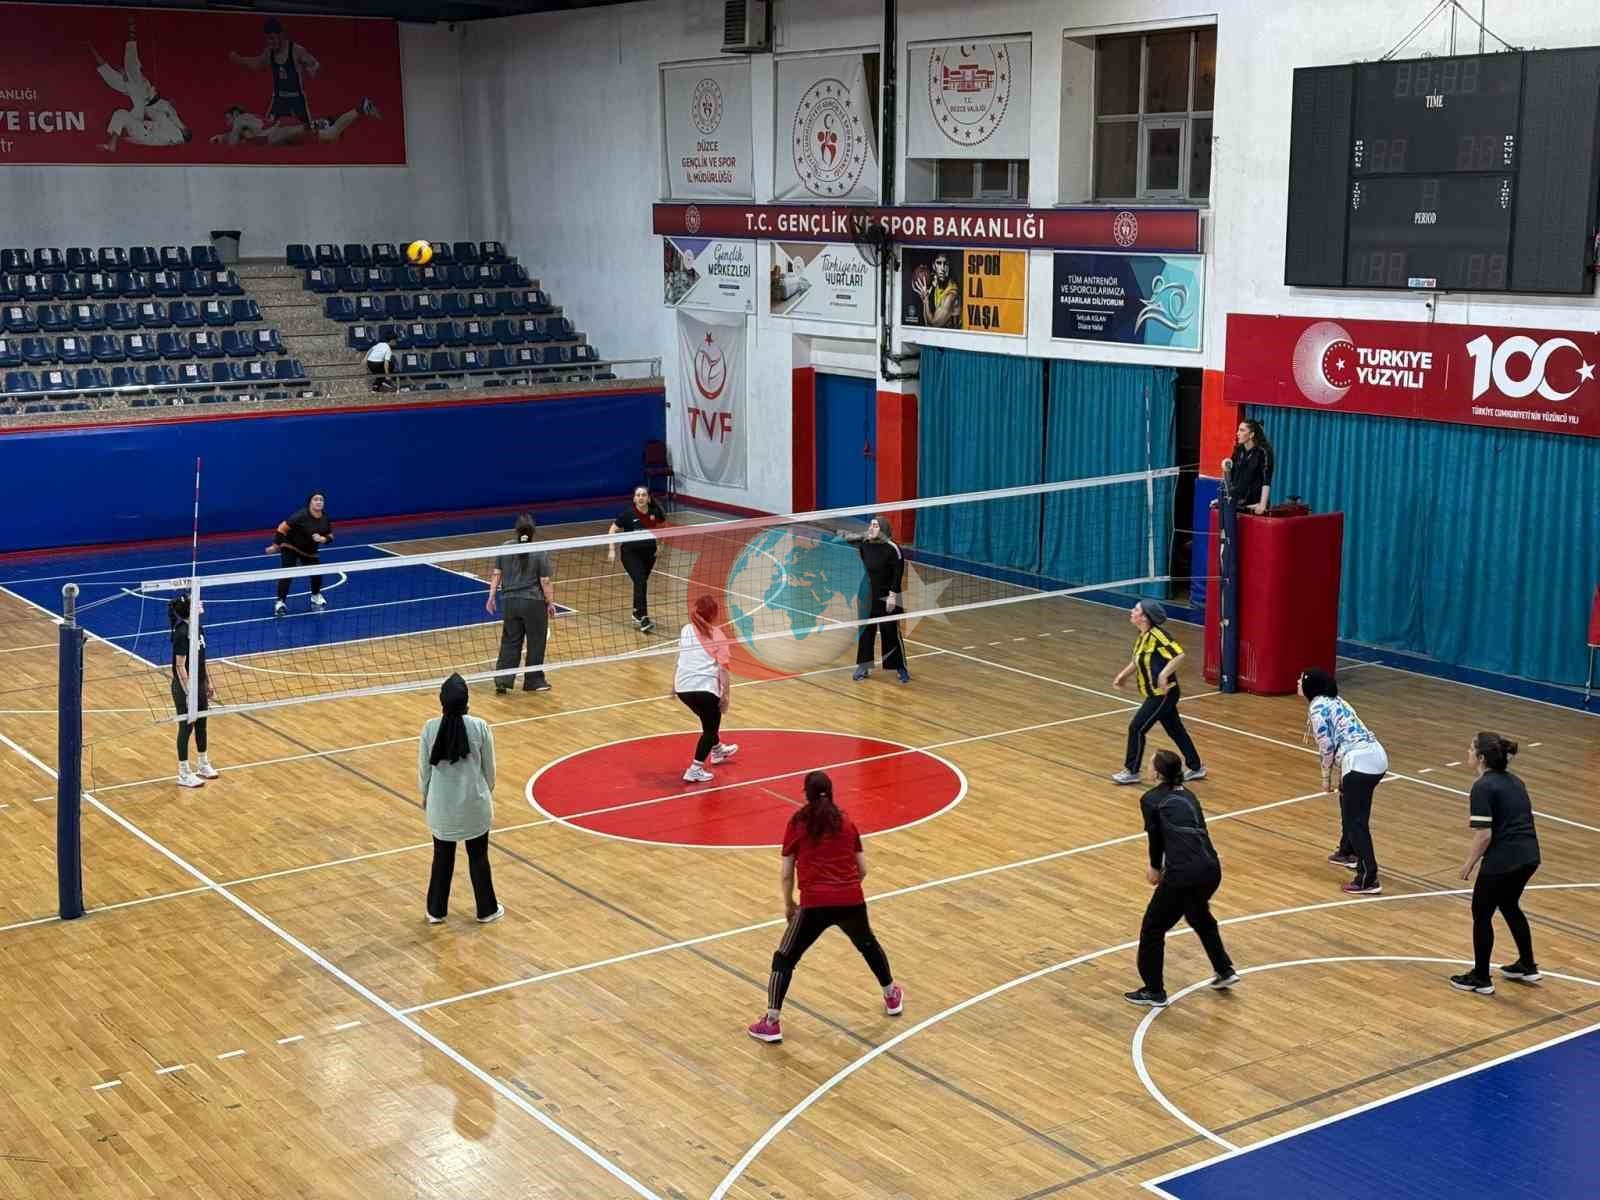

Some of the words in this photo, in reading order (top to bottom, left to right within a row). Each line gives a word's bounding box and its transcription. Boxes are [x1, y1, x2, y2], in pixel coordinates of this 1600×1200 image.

[709, 156, 718, 167] VE
[718, 157, 736, 168] SPOR
[746, 213, 772, 231] T.C.
[778, 210, 848, 235] GENÇLİK
[881, 216, 926, 236] SPOR
[933, 214, 1045, 239] BAKANLIĞI
[968, 254, 1000, 275] SPOR
[968, 277, 983, 298] LA
[1060, 284, 1069, 293] VE
[1070, 285, 1125, 296] SPORCULARIMIZA
[1068, 274, 1082, 284] TÜM
[1083, 275, 1118, 286] ANTRENÖR
[967, 304, 1000, 329] YAŞA
[1472, 406, 1494, 417] TÜRKİYE
[687, 407, 732, 444] TVF
